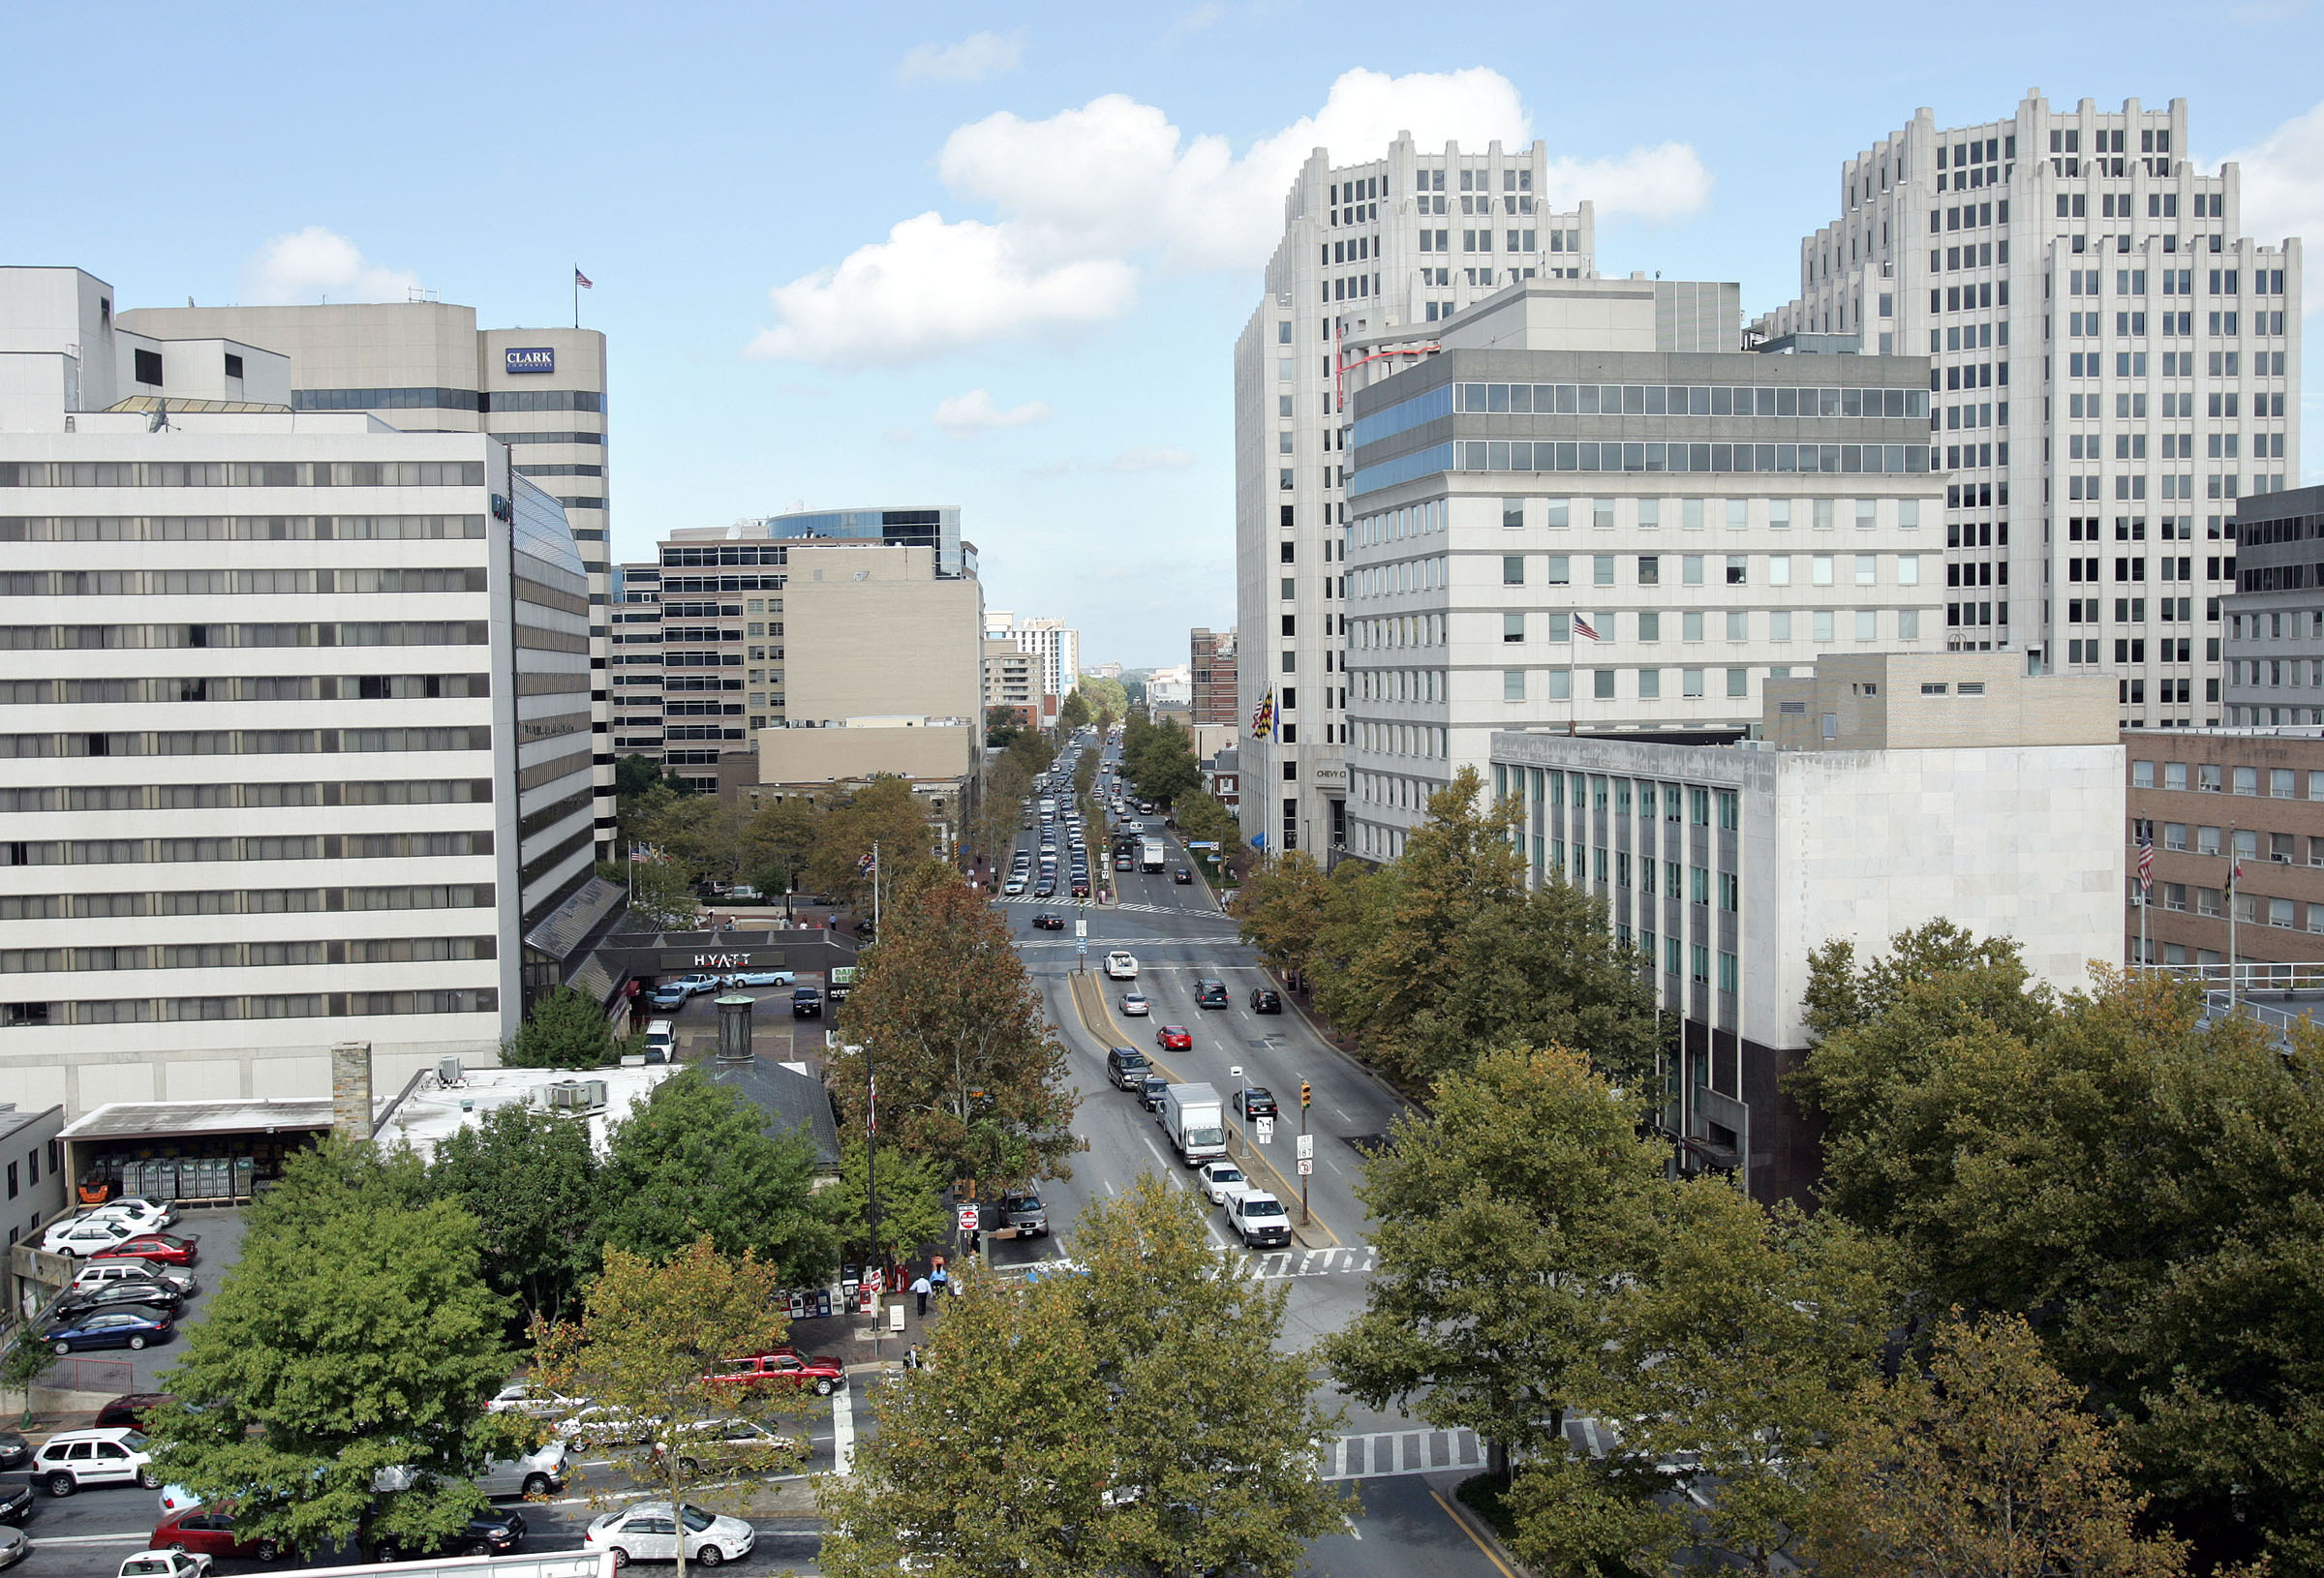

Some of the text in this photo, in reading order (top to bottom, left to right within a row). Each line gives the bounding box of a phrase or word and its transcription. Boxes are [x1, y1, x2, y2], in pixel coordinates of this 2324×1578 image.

[506, 352, 551, 363] CLARK
[1317, 770, 1338, 778] CHEVY
[694, 953, 750, 968] HYATT
[1299, 1148, 1311, 1158] 187
